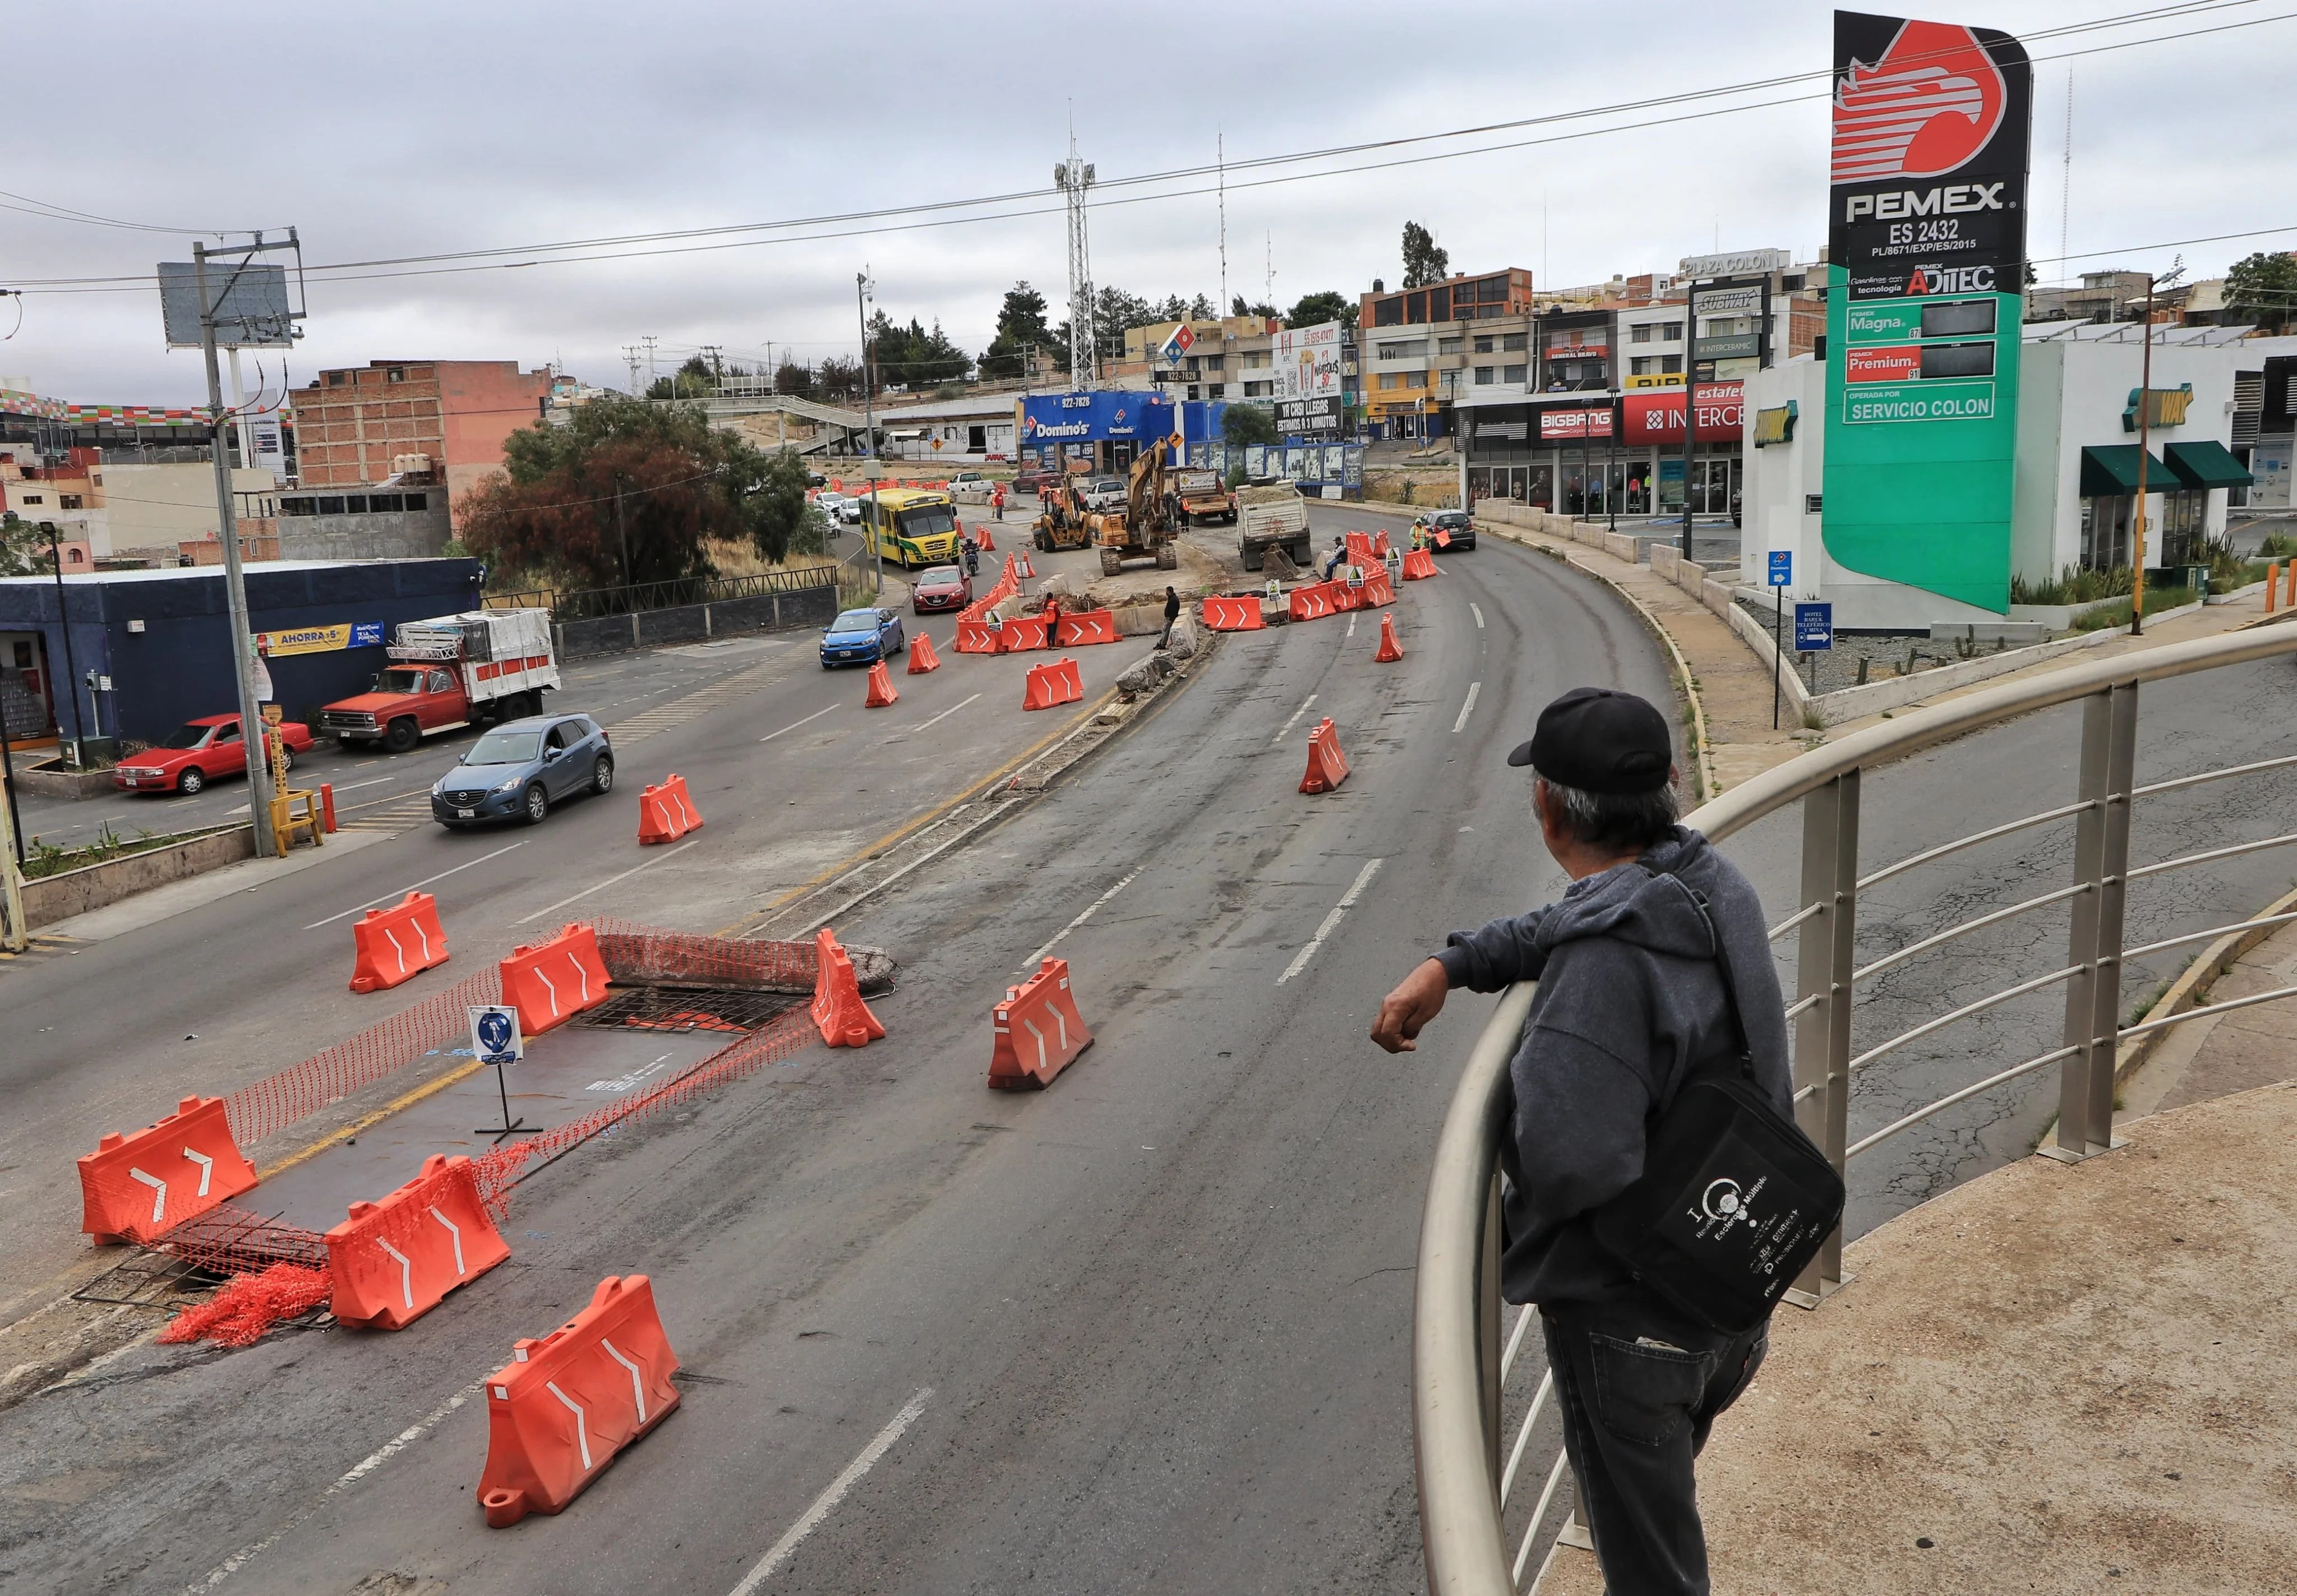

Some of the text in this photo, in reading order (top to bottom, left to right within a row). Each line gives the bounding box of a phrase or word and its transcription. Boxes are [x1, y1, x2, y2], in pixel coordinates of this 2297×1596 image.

[1846, 182, 2004, 223] PEMEX
[1890, 219, 1958, 244] ES 2432
[1871, 239, 1976, 257] PL/8671/EXP/ES/2015
[1685, 260, 1725, 275] PLAZA
[1851, 276, 1887, 285] Gasolinas
[1858, 284, 1902, 294] tecnología
[1698, 289, 1758, 313] SUBWAY
[1851, 317, 1901, 332] Magna
[1910, 329, 1918, 338] 87
[1706, 342, 1751, 352] INTERCERAMIC
[1849, 356, 1912, 370] Premium
[1167, 371, 1197, 381] 922-7828
[1909, 370, 1918, 379] 91
[1062, 396, 1090, 408] 922-7828
[1282, 403, 1289, 417] YA
[1290, 402, 1304, 417] CASI
[1306, 399, 1329, 415] LLEGAS
[1852, 398, 1989, 419] SERVICIO COLON
[1277, 415, 1337, 432] ESTAMOS A 3 MINUTOS
[1541, 412, 1611, 427] BIGBANG
[1037, 421, 1088, 437] Domino's
[1109, 426, 1133, 434] Domino's
[281, 631, 325, 644] AHORRA
[276, 732, 282, 743] NO
[272, 755, 281, 794] NATURAL
[1743, 1175, 1767, 1205] Múltiple
